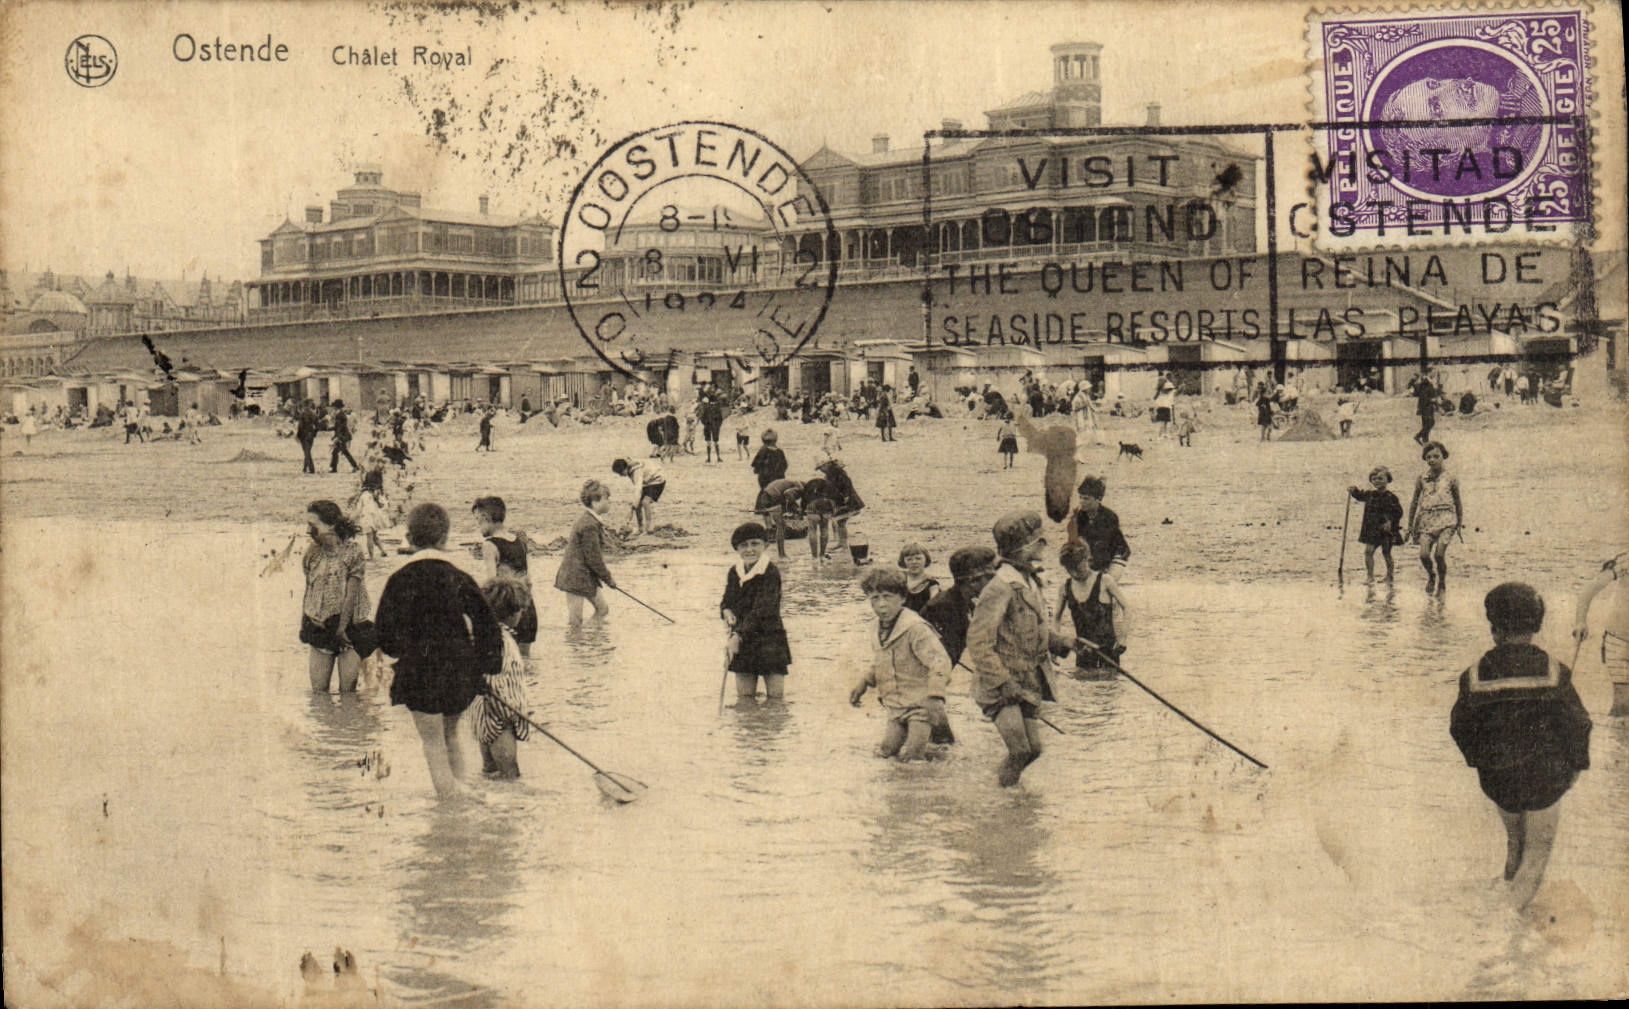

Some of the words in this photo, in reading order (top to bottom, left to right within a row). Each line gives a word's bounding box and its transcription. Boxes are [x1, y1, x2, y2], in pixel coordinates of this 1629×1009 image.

[1531, 19, 1563, 55] 25
[1336, 62, 1356, 193] BELGIQUE
[578, 130, 815, 231] OOSTENDE
[1017, 155, 1180, 190] VISIT
[1307, 146, 1524, 184] VISITAD
[1540, 180, 1570, 216] 25
[982, 200, 1218, 244] OSTEND
[575, 249, 600, 289] 2
[793, 249, 819, 288] 2
[941, 262, 1019, 296] THE
[1041, 260, 1184, 298] QUEEN
[1210, 258, 1257, 291] OF
[1301, 255, 1449, 290] REINA
[1481, 251, 1543, 285] DE
[942, 312, 1088, 347] SEASIDE
[1106, 308, 1261, 345] RESORTS
[1287, 307, 1365, 341] LAS
[1398, 302, 1562, 337] PLAYAS
